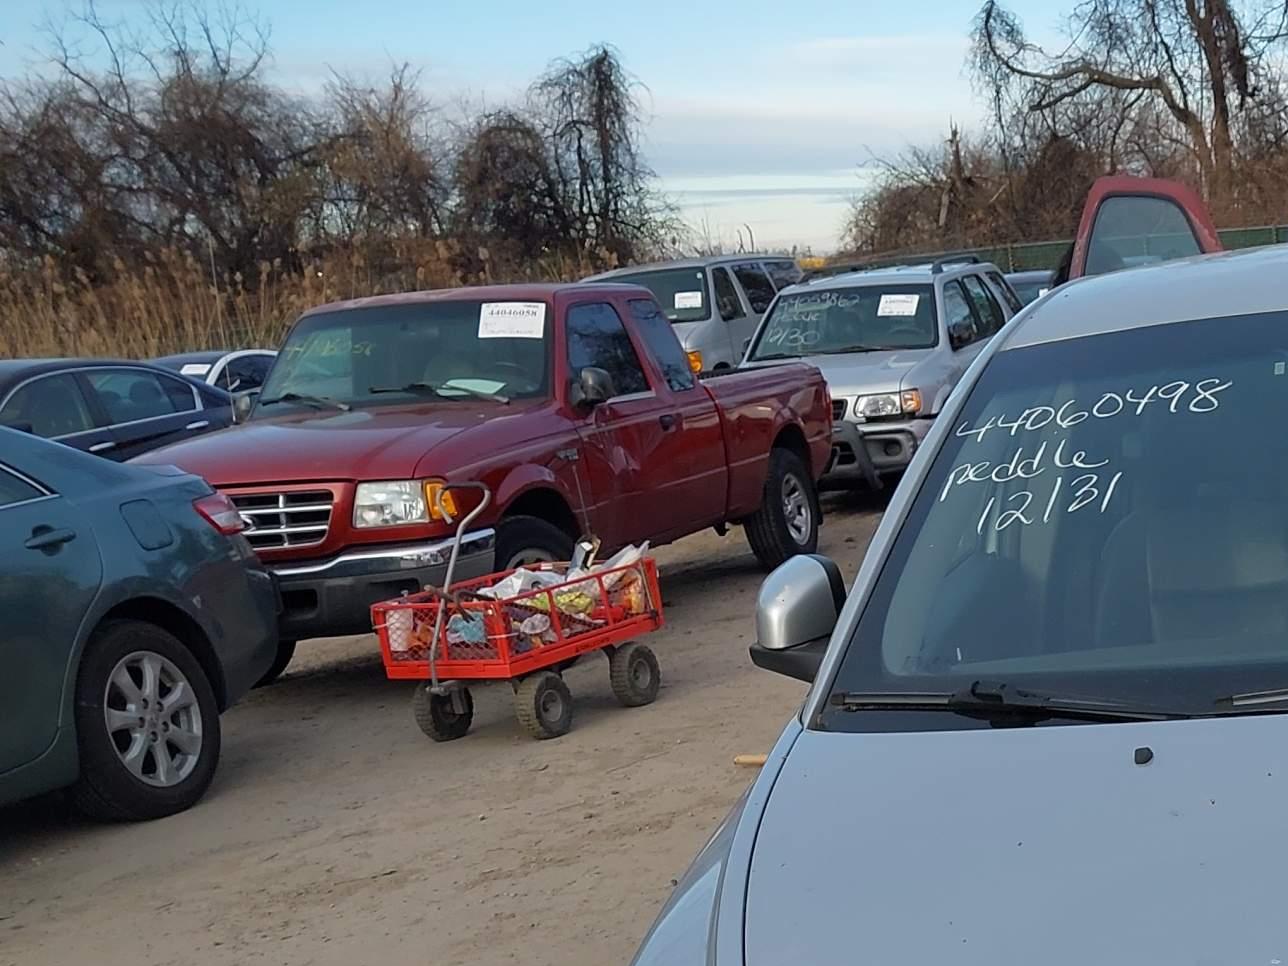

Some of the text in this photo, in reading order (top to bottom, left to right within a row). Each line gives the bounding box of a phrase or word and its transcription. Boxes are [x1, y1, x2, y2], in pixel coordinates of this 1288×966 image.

[956, 379, 1233, 442] 44060498
[940, 439, 1109, 501] peddle
[977, 472, 1122, 535] 12/31
